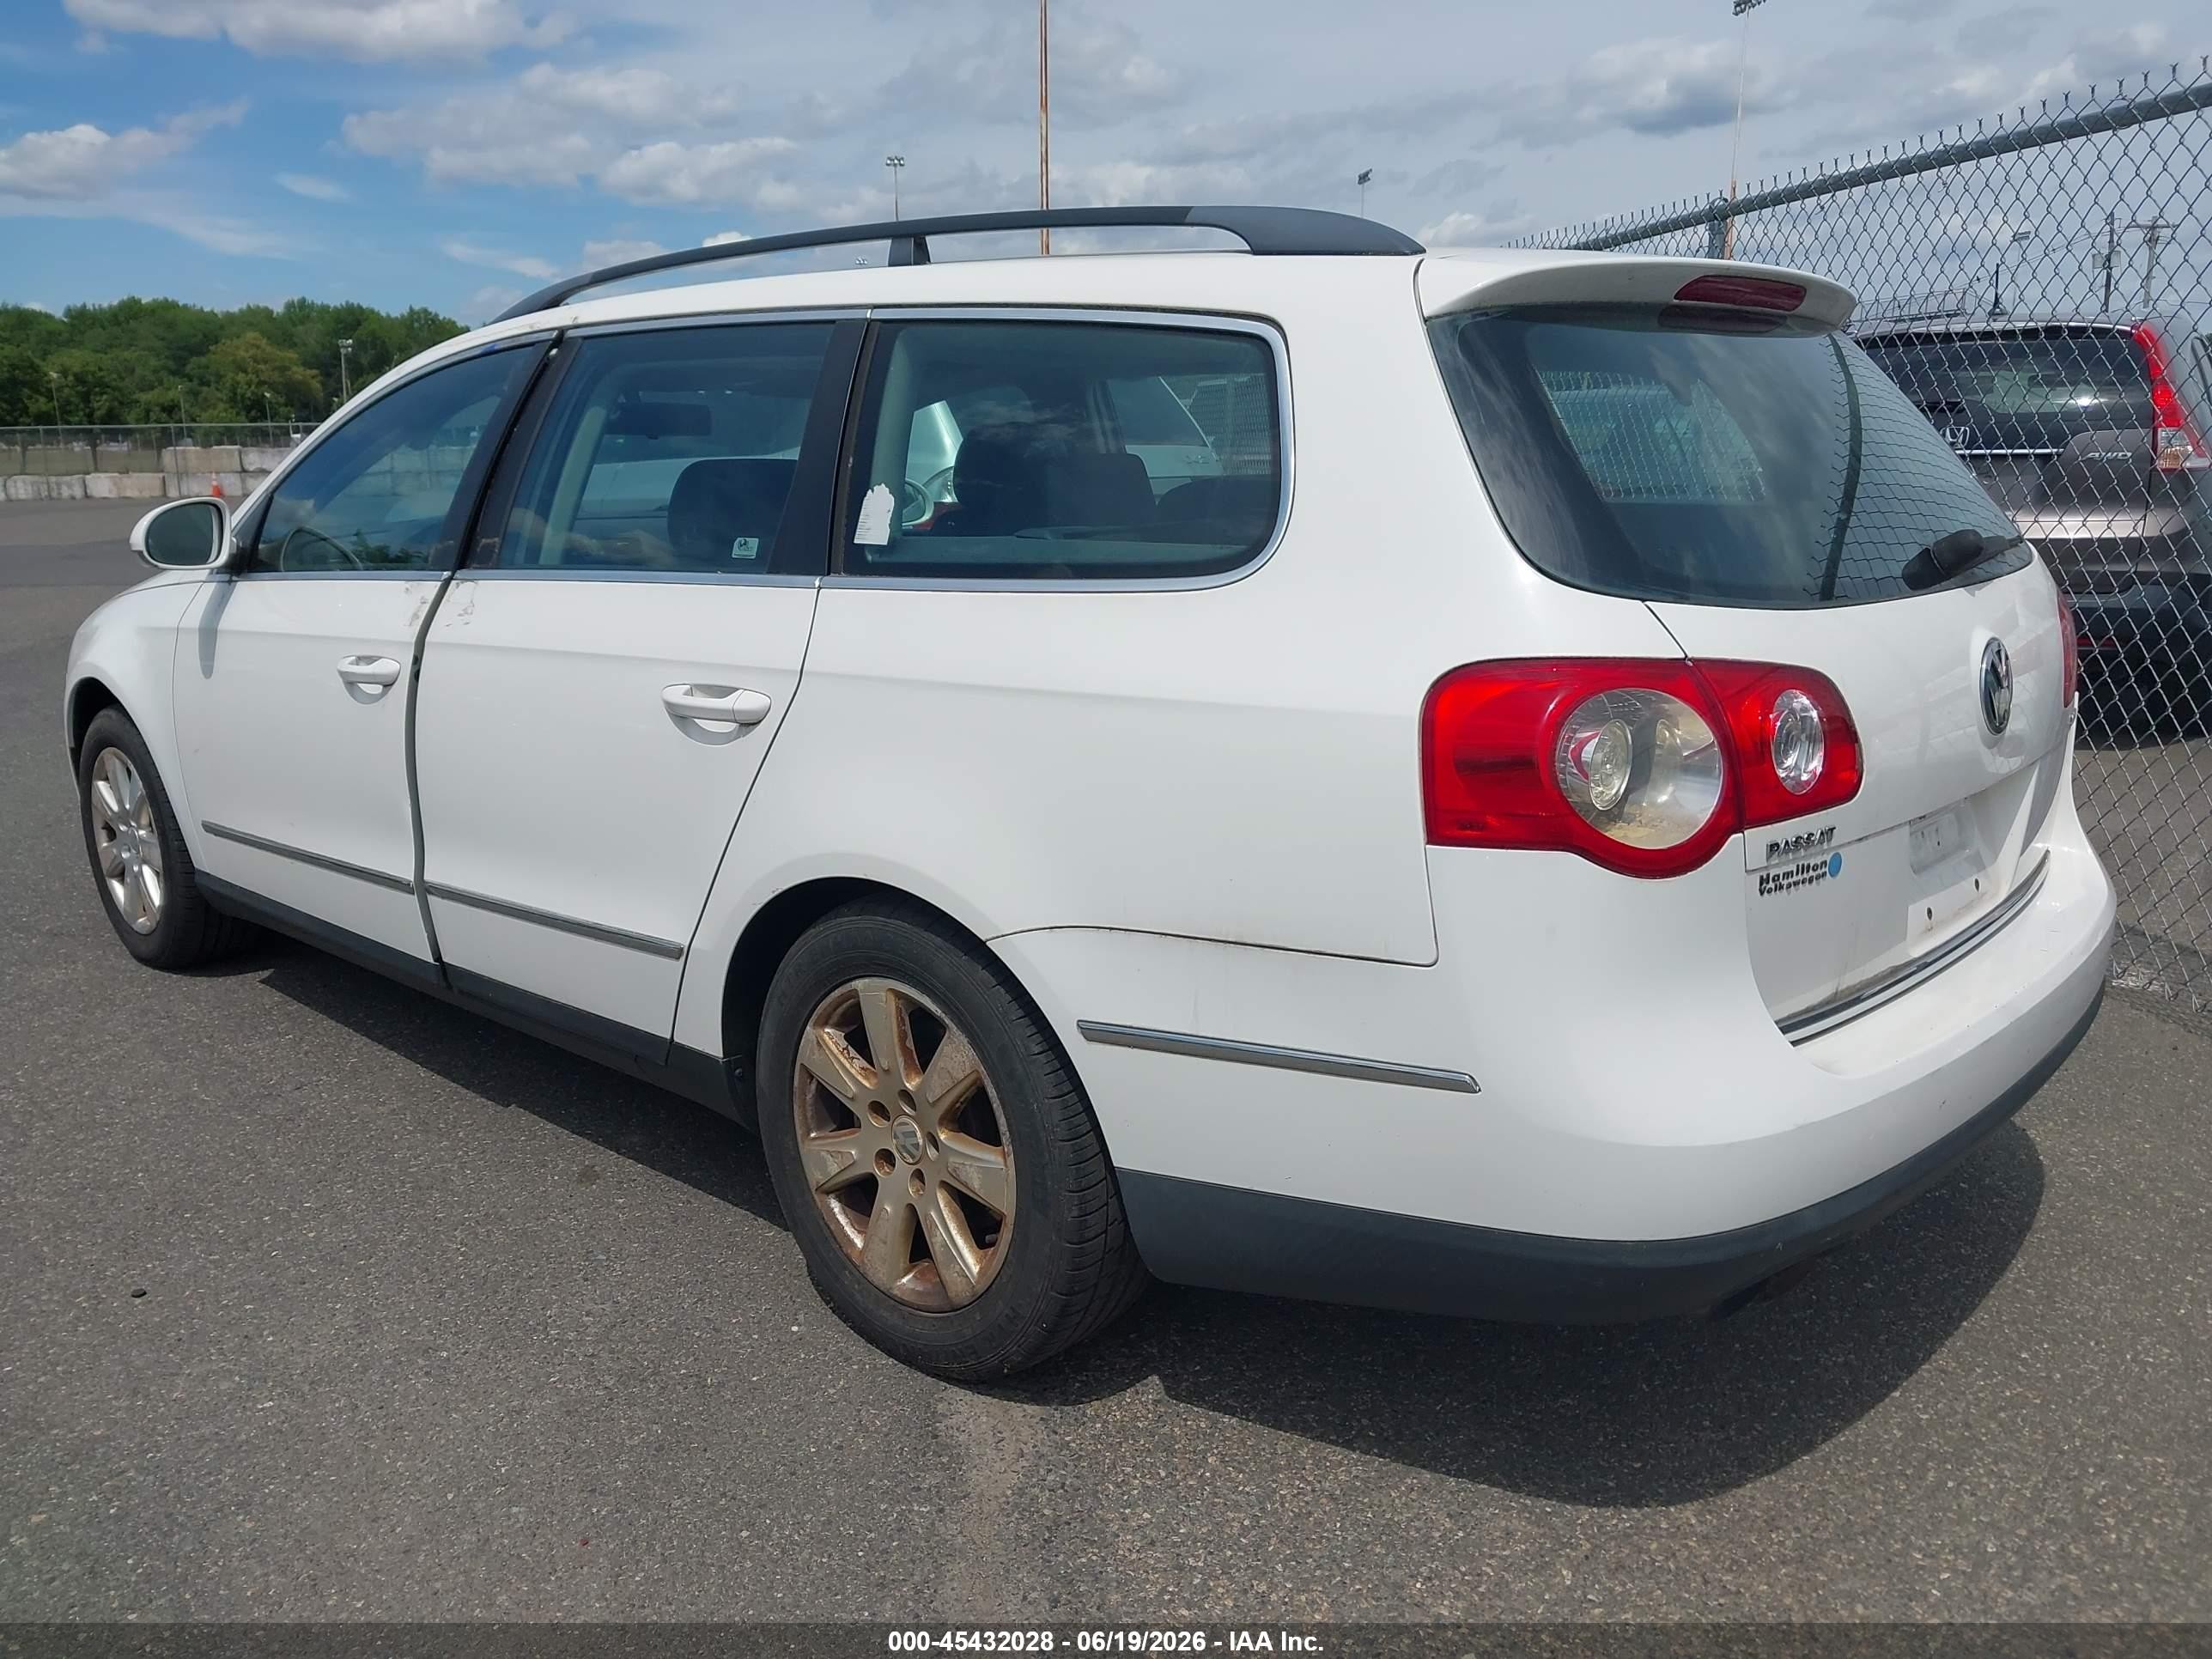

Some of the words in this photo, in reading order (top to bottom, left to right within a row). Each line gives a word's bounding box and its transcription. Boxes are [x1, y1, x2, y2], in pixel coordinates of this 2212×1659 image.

[1766, 826, 1836, 858] PASSAT
[1759, 860, 1827, 885] Hamilton
[1759, 871, 1826, 896] Volkswagen
